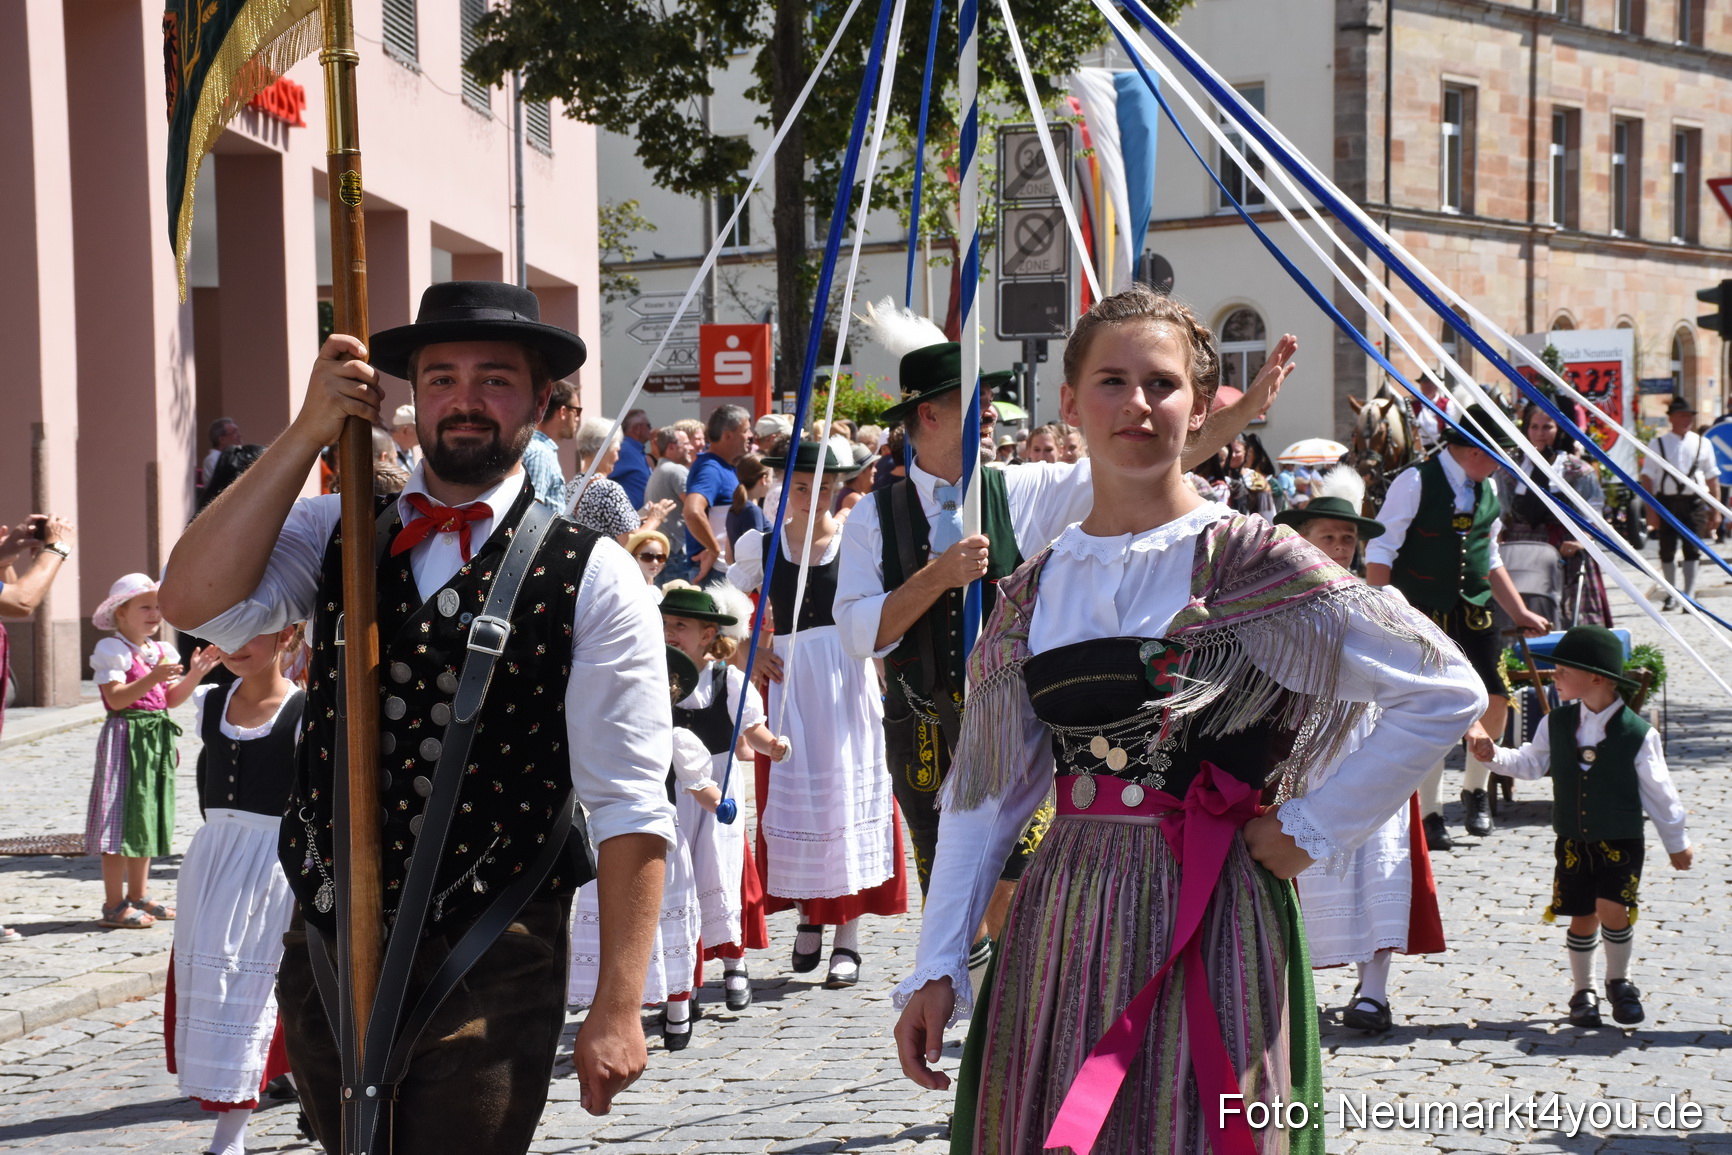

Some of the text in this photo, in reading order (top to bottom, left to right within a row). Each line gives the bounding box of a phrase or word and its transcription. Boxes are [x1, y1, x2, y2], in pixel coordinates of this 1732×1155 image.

[1019, 183, 1050, 195] ZONE
[1018, 259, 1050, 272] ZONE
[667, 349, 698, 364] AOK
[1583, 346, 1624, 358] Neumarkt
